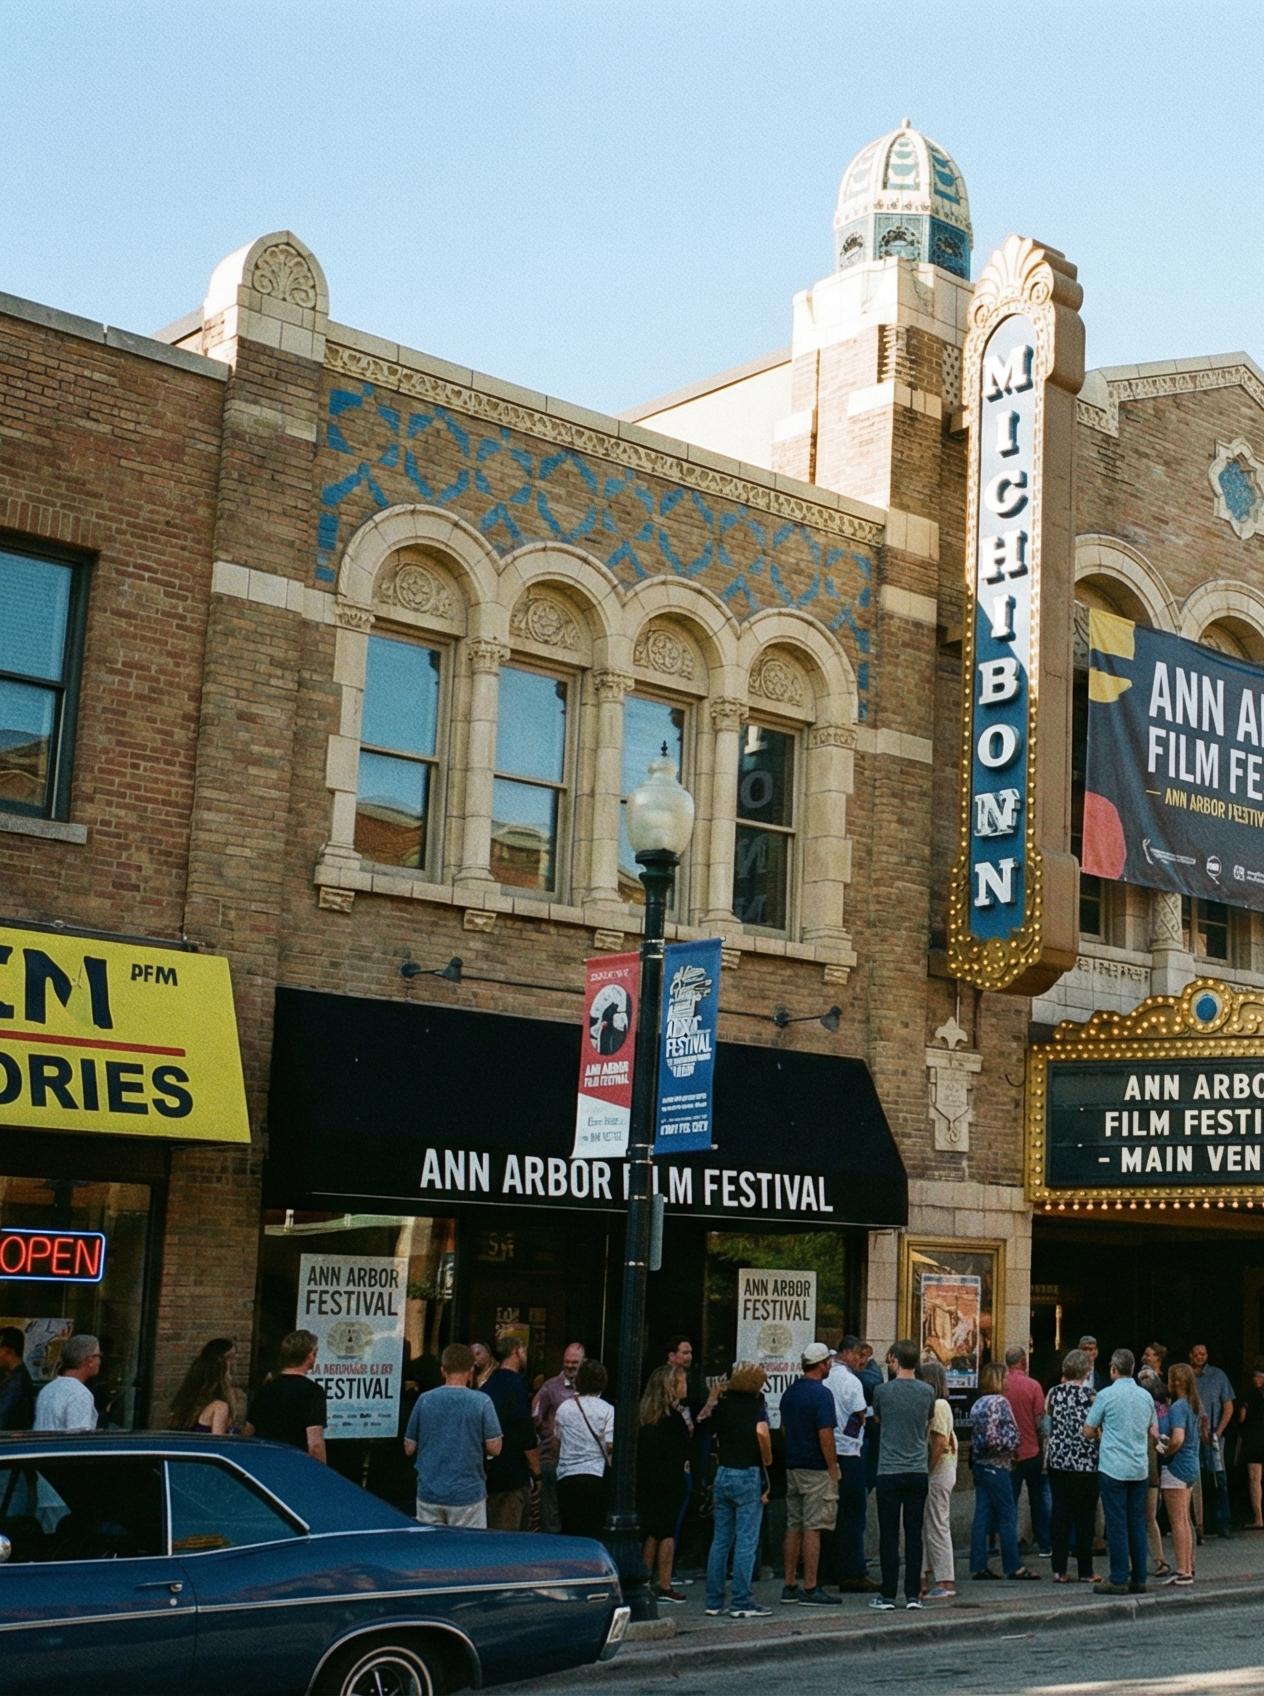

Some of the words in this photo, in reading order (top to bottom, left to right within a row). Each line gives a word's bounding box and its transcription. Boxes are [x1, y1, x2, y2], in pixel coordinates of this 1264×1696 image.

[1149, 661, 1224, 736] ANN
[1147, 725, 1219, 789] FILM
[1165, 788, 1187, 809] ANN
[1189, 793, 1226, 818] ARBOR
[131, 964, 178, 986] PFM
[1124, 1074, 1179, 1100] ANN
[1105, 1110, 1170, 1136] FILM
[1121, 1146, 1193, 1173] MAIN
[420, 1148, 490, 1193] ANN
[502, 1154, 614, 1200] ARBOR
[704, 1169, 834, 1212] FESTIVAL
[0, 1236, 100, 1276] OPEN
[307, 1265, 341, 1287] ANN
[347, 1267, 399, 1289] ARBOR
[744, 1278, 768, 1297] ANN
[772, 1279, 811, 1298] ARBOR
[305, 1290, 398, 1316] FESTIVAL
[743, 1299, 810, 1321] FESTIVAL
